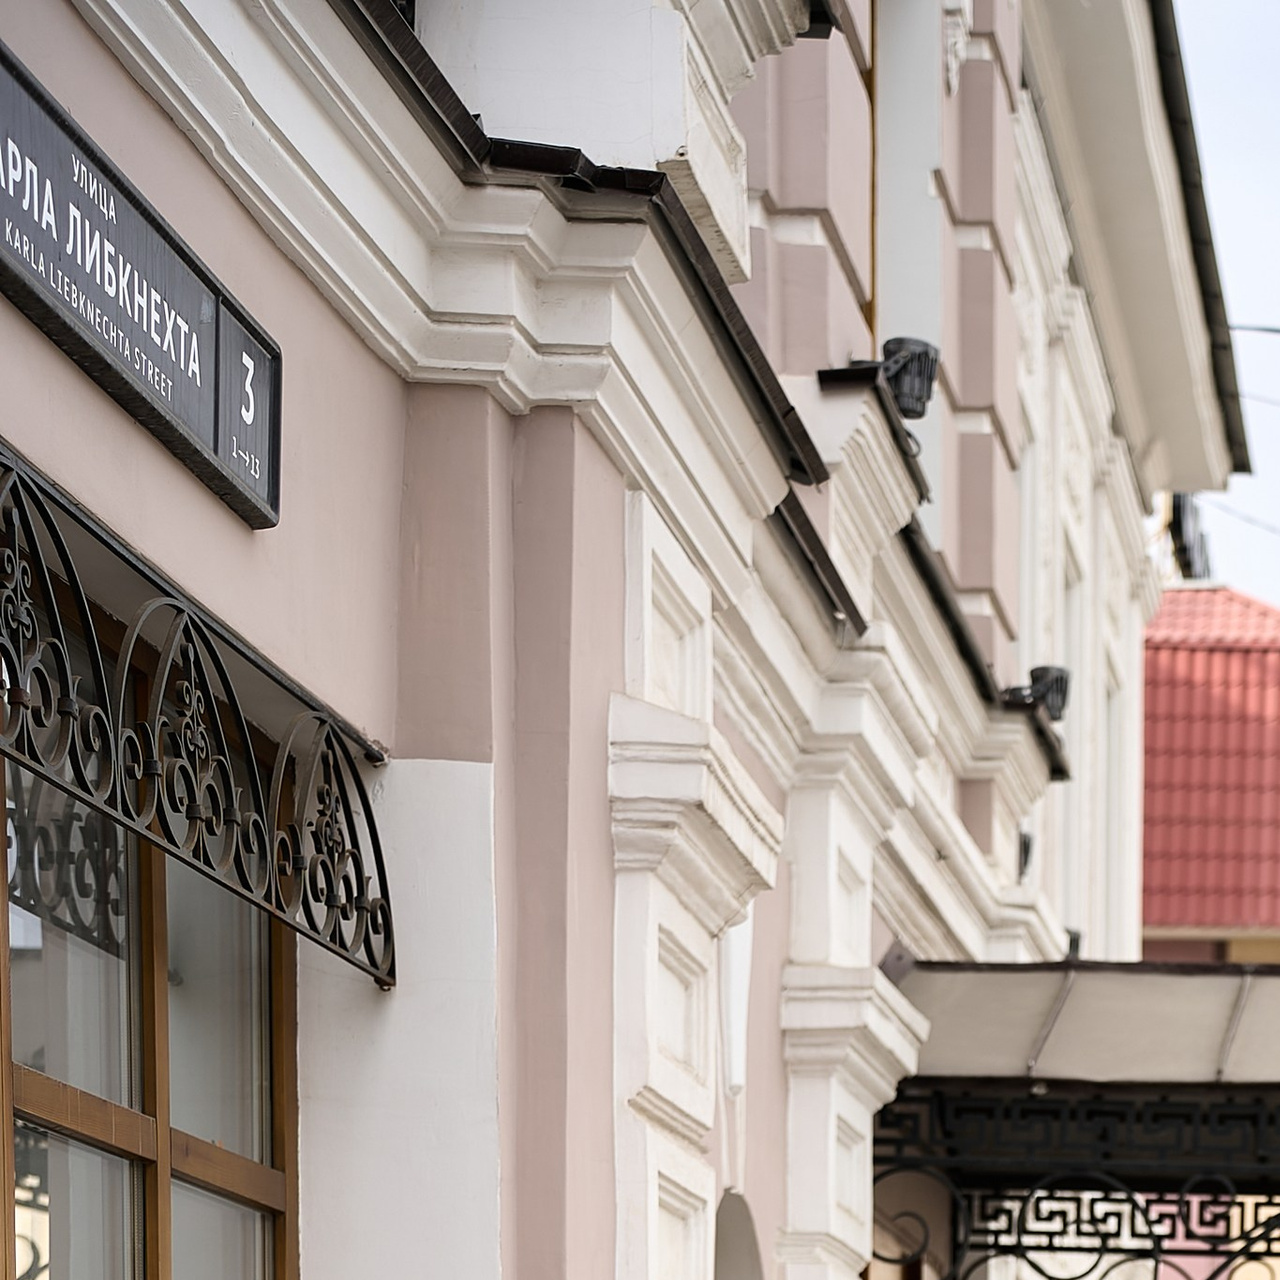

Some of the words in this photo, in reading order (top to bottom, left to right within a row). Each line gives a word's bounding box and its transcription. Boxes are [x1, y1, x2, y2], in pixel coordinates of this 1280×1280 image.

[72, 153, 117, 224] УЛИЦА
[5, 218, 46, 278] KARLA
[50, 262, 131, 362] LIEBKNECHTA
[134, 346, 173, 401] STREET
[66, 202, 201, 387] ЛИБКНЕХТА
[240, 351, 256, 425] 3
